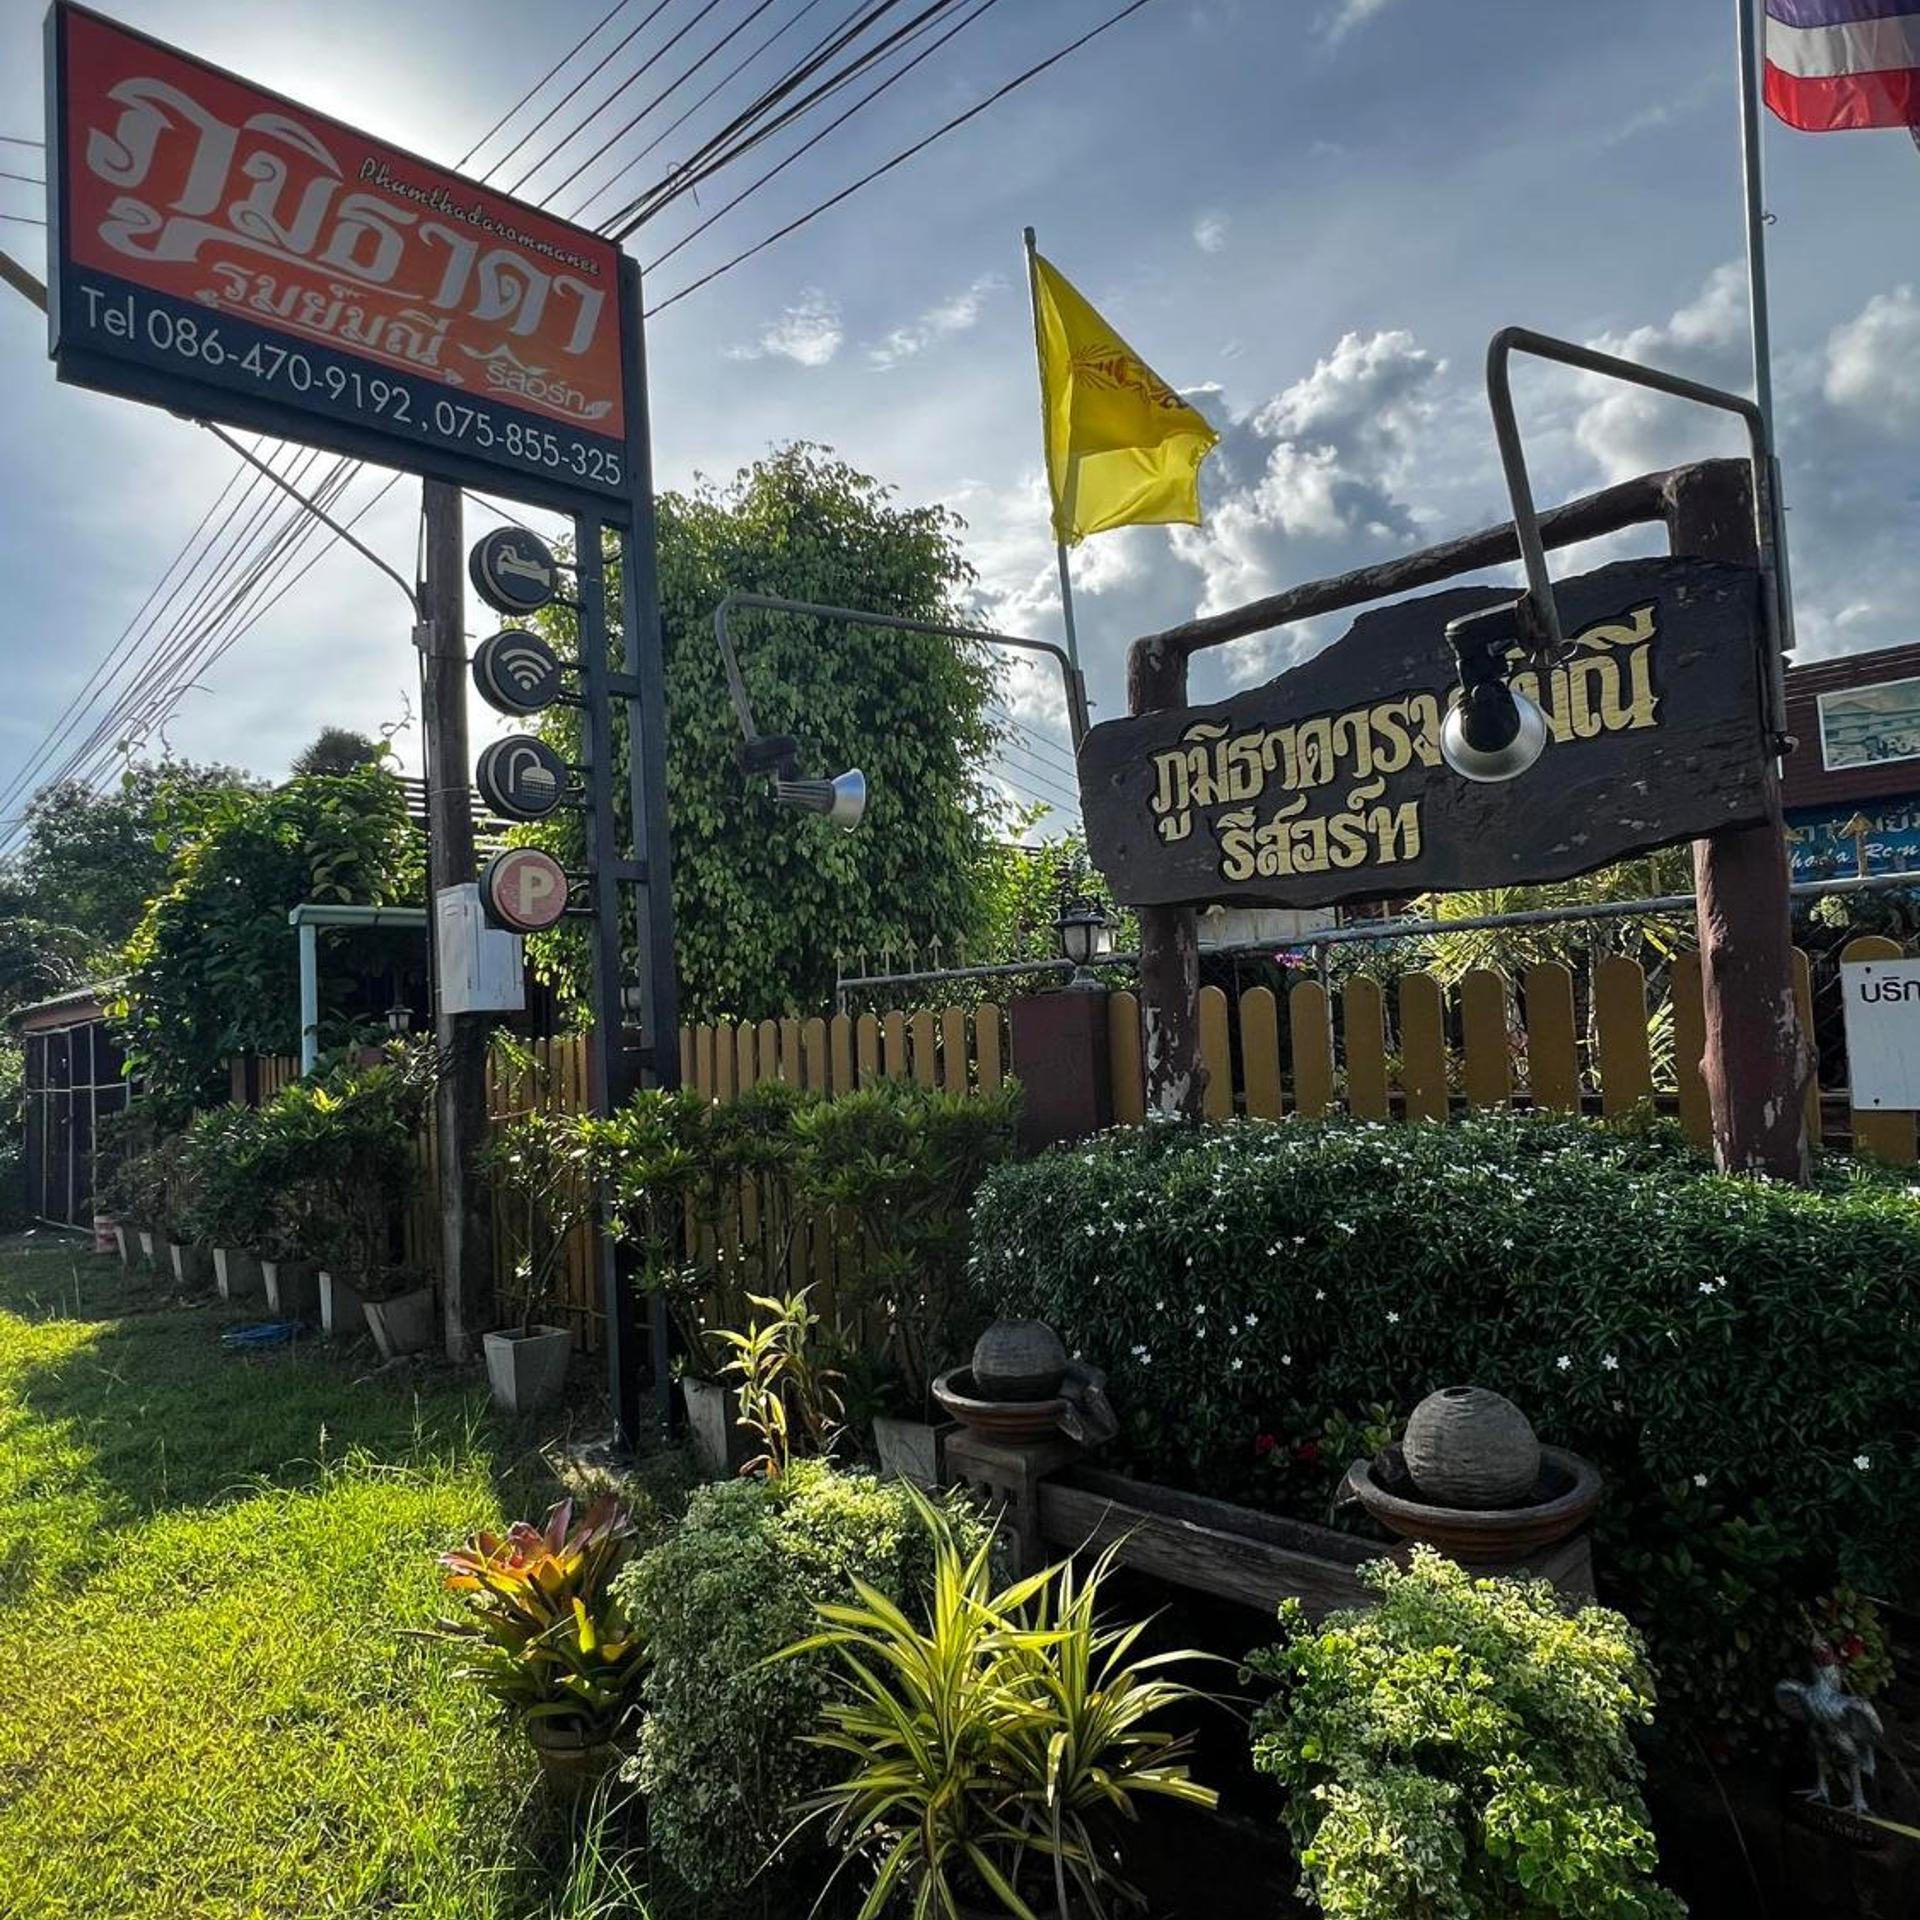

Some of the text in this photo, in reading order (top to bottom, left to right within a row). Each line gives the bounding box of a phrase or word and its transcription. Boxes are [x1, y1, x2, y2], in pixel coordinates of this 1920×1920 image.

[86, 77, 605, 355] ภูมิธาดา
[80, 286, 135, 340] Tel
[434, 401, 622, 486] 075-855-325
[519, 865, 556, 915] P
[1217, 775, 1421, 881] รีสอร์ท
